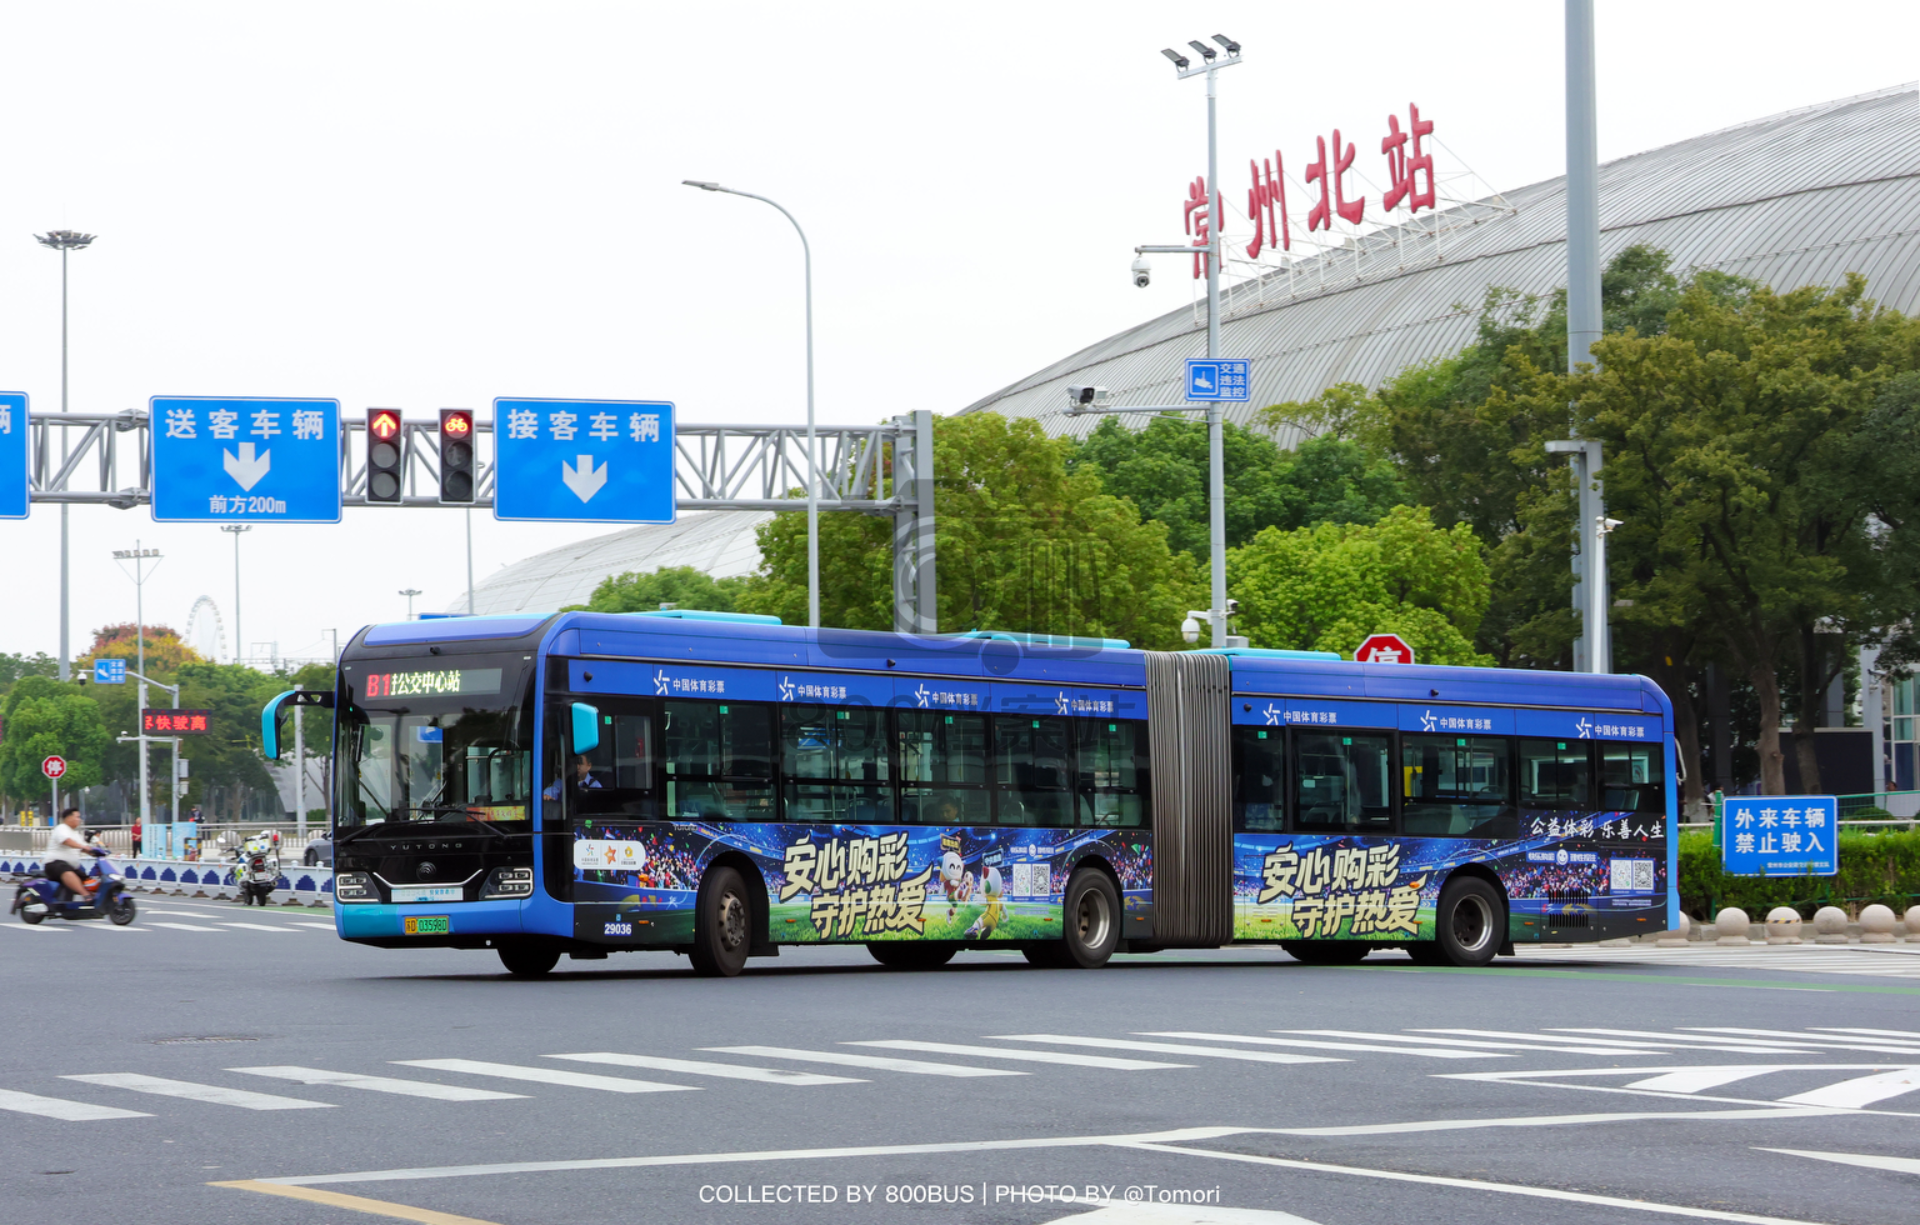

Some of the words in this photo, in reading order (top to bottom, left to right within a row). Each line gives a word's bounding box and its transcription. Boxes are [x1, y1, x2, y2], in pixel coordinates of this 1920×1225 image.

[1184, 102, 1433, 279] 常州北站
[1220, 363, 1245, 374] 交通
[1220, 375, 1245, 385] 违法
[1220, 386, 1245, 397] 监控
[165, 409, 324, 440] 送客车辆
[508, 408, 660, 442] 接客车辆
[209, 495, 286, 514] 前方200m
[366, 674, 390, 697] B1
[673, 678, 725, 693] 中国体育彩票
[797, 684, 847, 699] 中国体育彩票
[932, 691, 978, 705] 中国体育彩票
[1071, 698, 1114, 712] 中国体育彩票
[1283, 710, 1337, 724] 中国体育彩票
[1439, 717, 1492, 730] 中国体育彩票
[1595, 724, 1645, 738] 中国体育彩票
[47, 760, 63, 774] 停
[1734, 807, 1826, 829] 外来车辆
[1530, 818, 1595, 839] 公益体彩
[1600, 818, 1665, 840] 乐善人生
[1735, 832, 1825, 854] 禁止驶入
[779, 831, 909, 903] 安心购彩
[1258, 841, 1401, 905] 安心购彩
[811, 863, 934, 940] 守护热爱
[1291, 874, 1428, 938] 守护热爱
[604, 923, 632, 936] 29036
